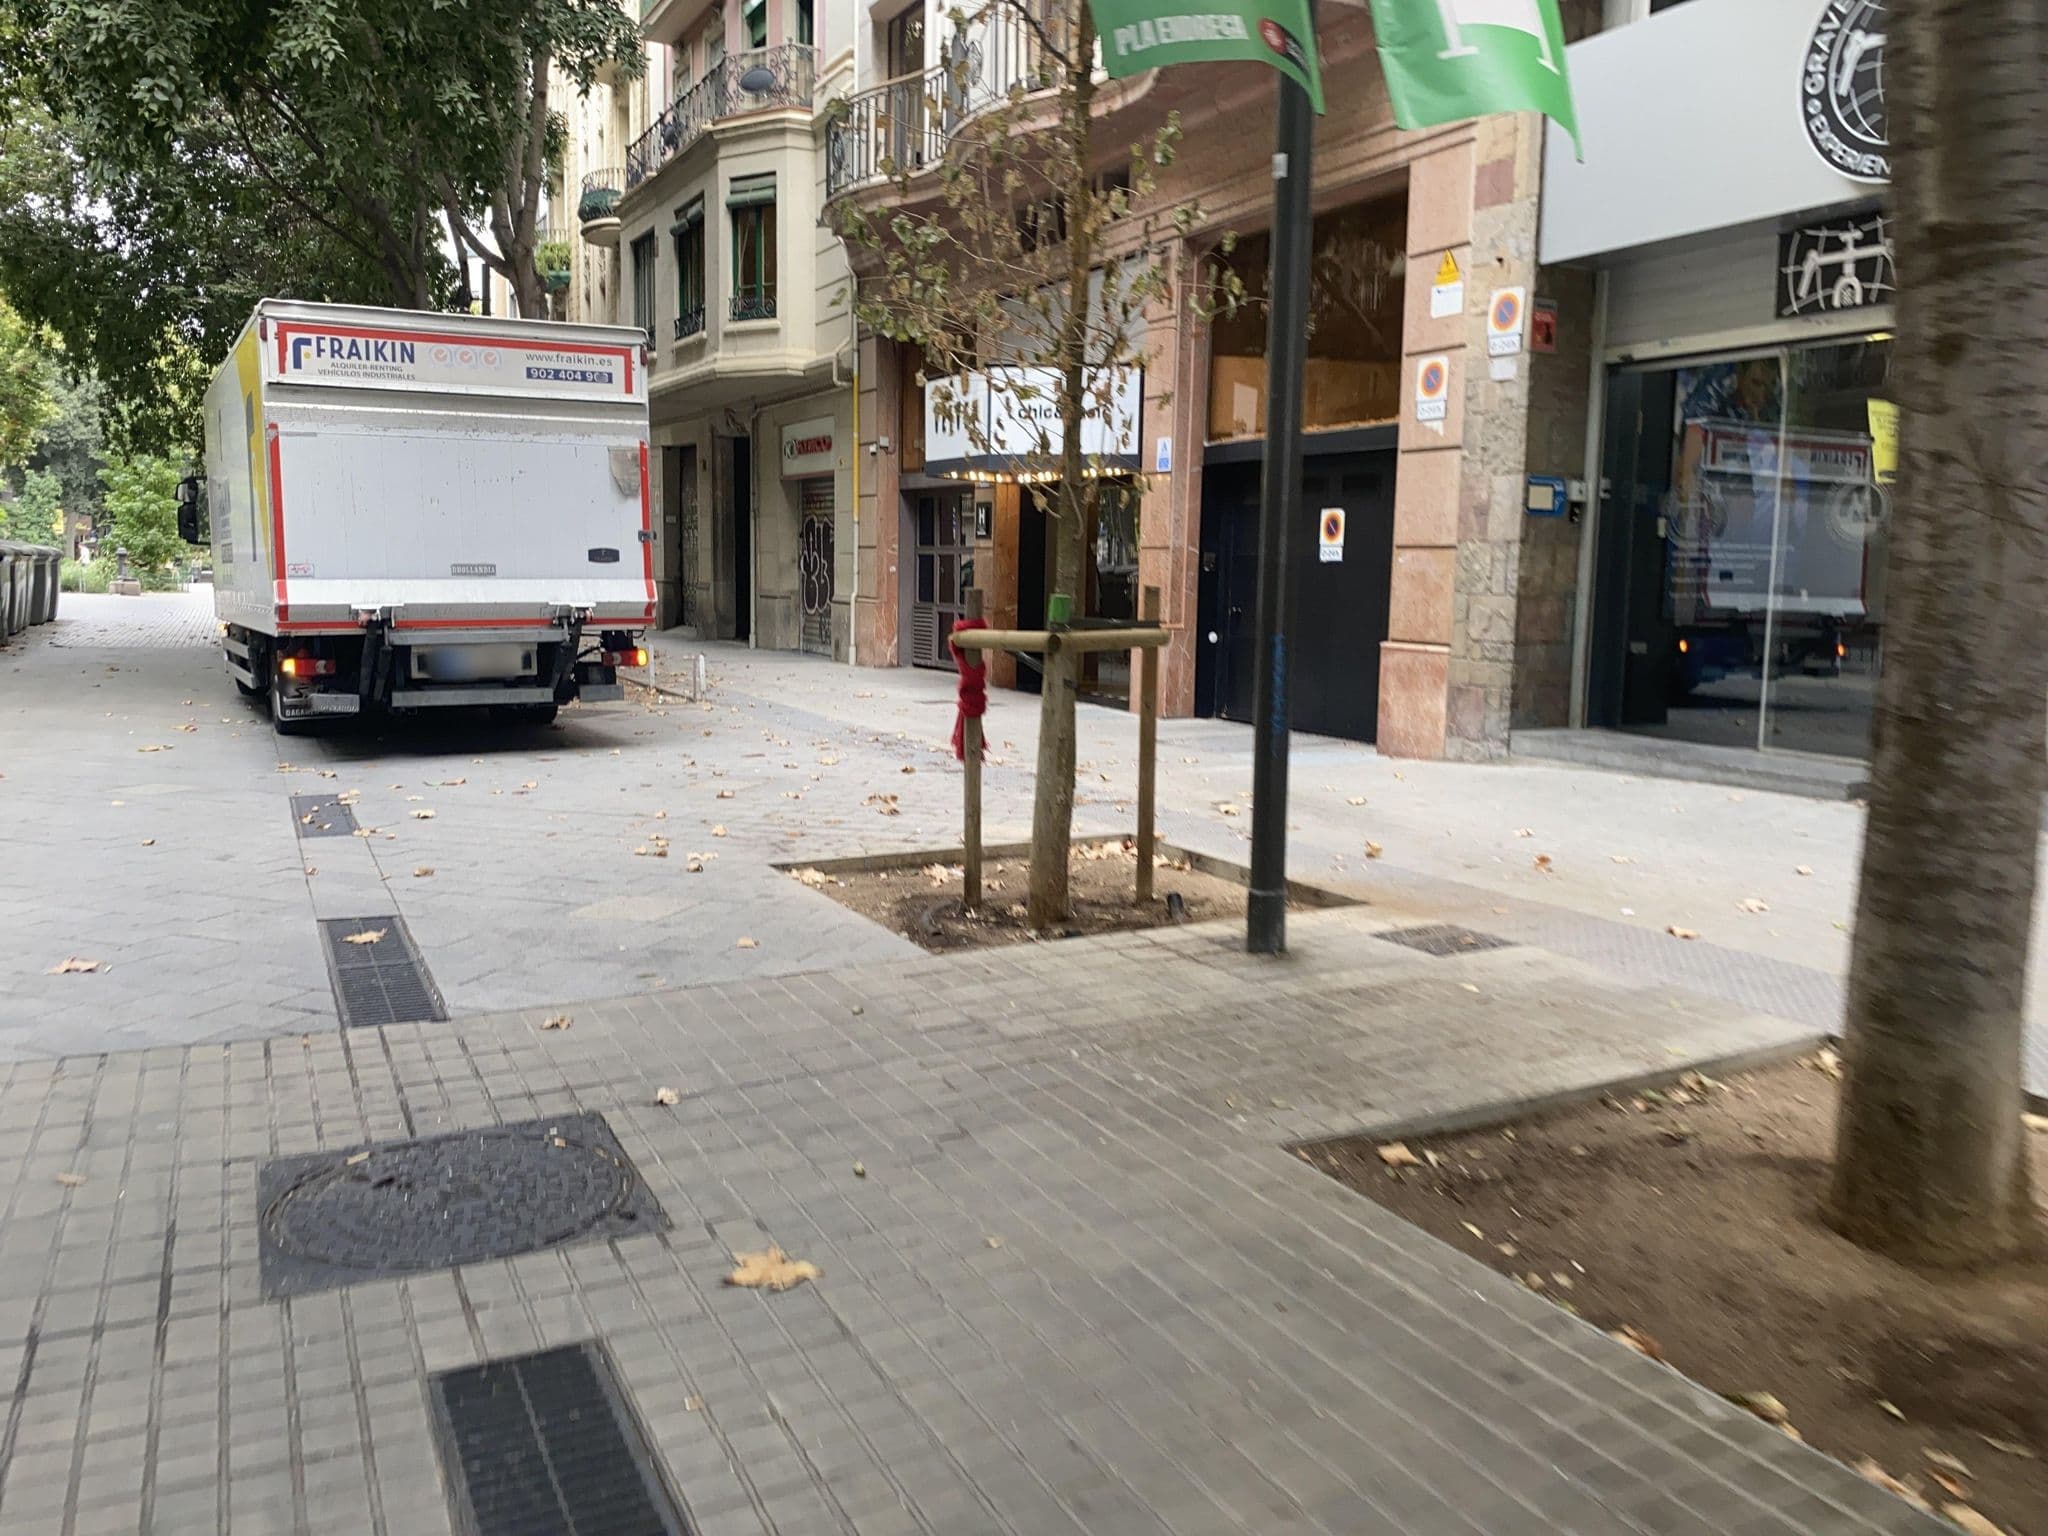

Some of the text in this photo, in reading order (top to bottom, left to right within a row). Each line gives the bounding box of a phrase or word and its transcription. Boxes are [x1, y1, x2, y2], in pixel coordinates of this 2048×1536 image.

[315, 335, 415, 364] FRAIKIN
[525, 352, 613, 367] www.fraikin.es
[362, 370, 416, 381] INDUSTRIALES
[530, 368, 555, 379] 902
[558, 369, 582, 381] 404
